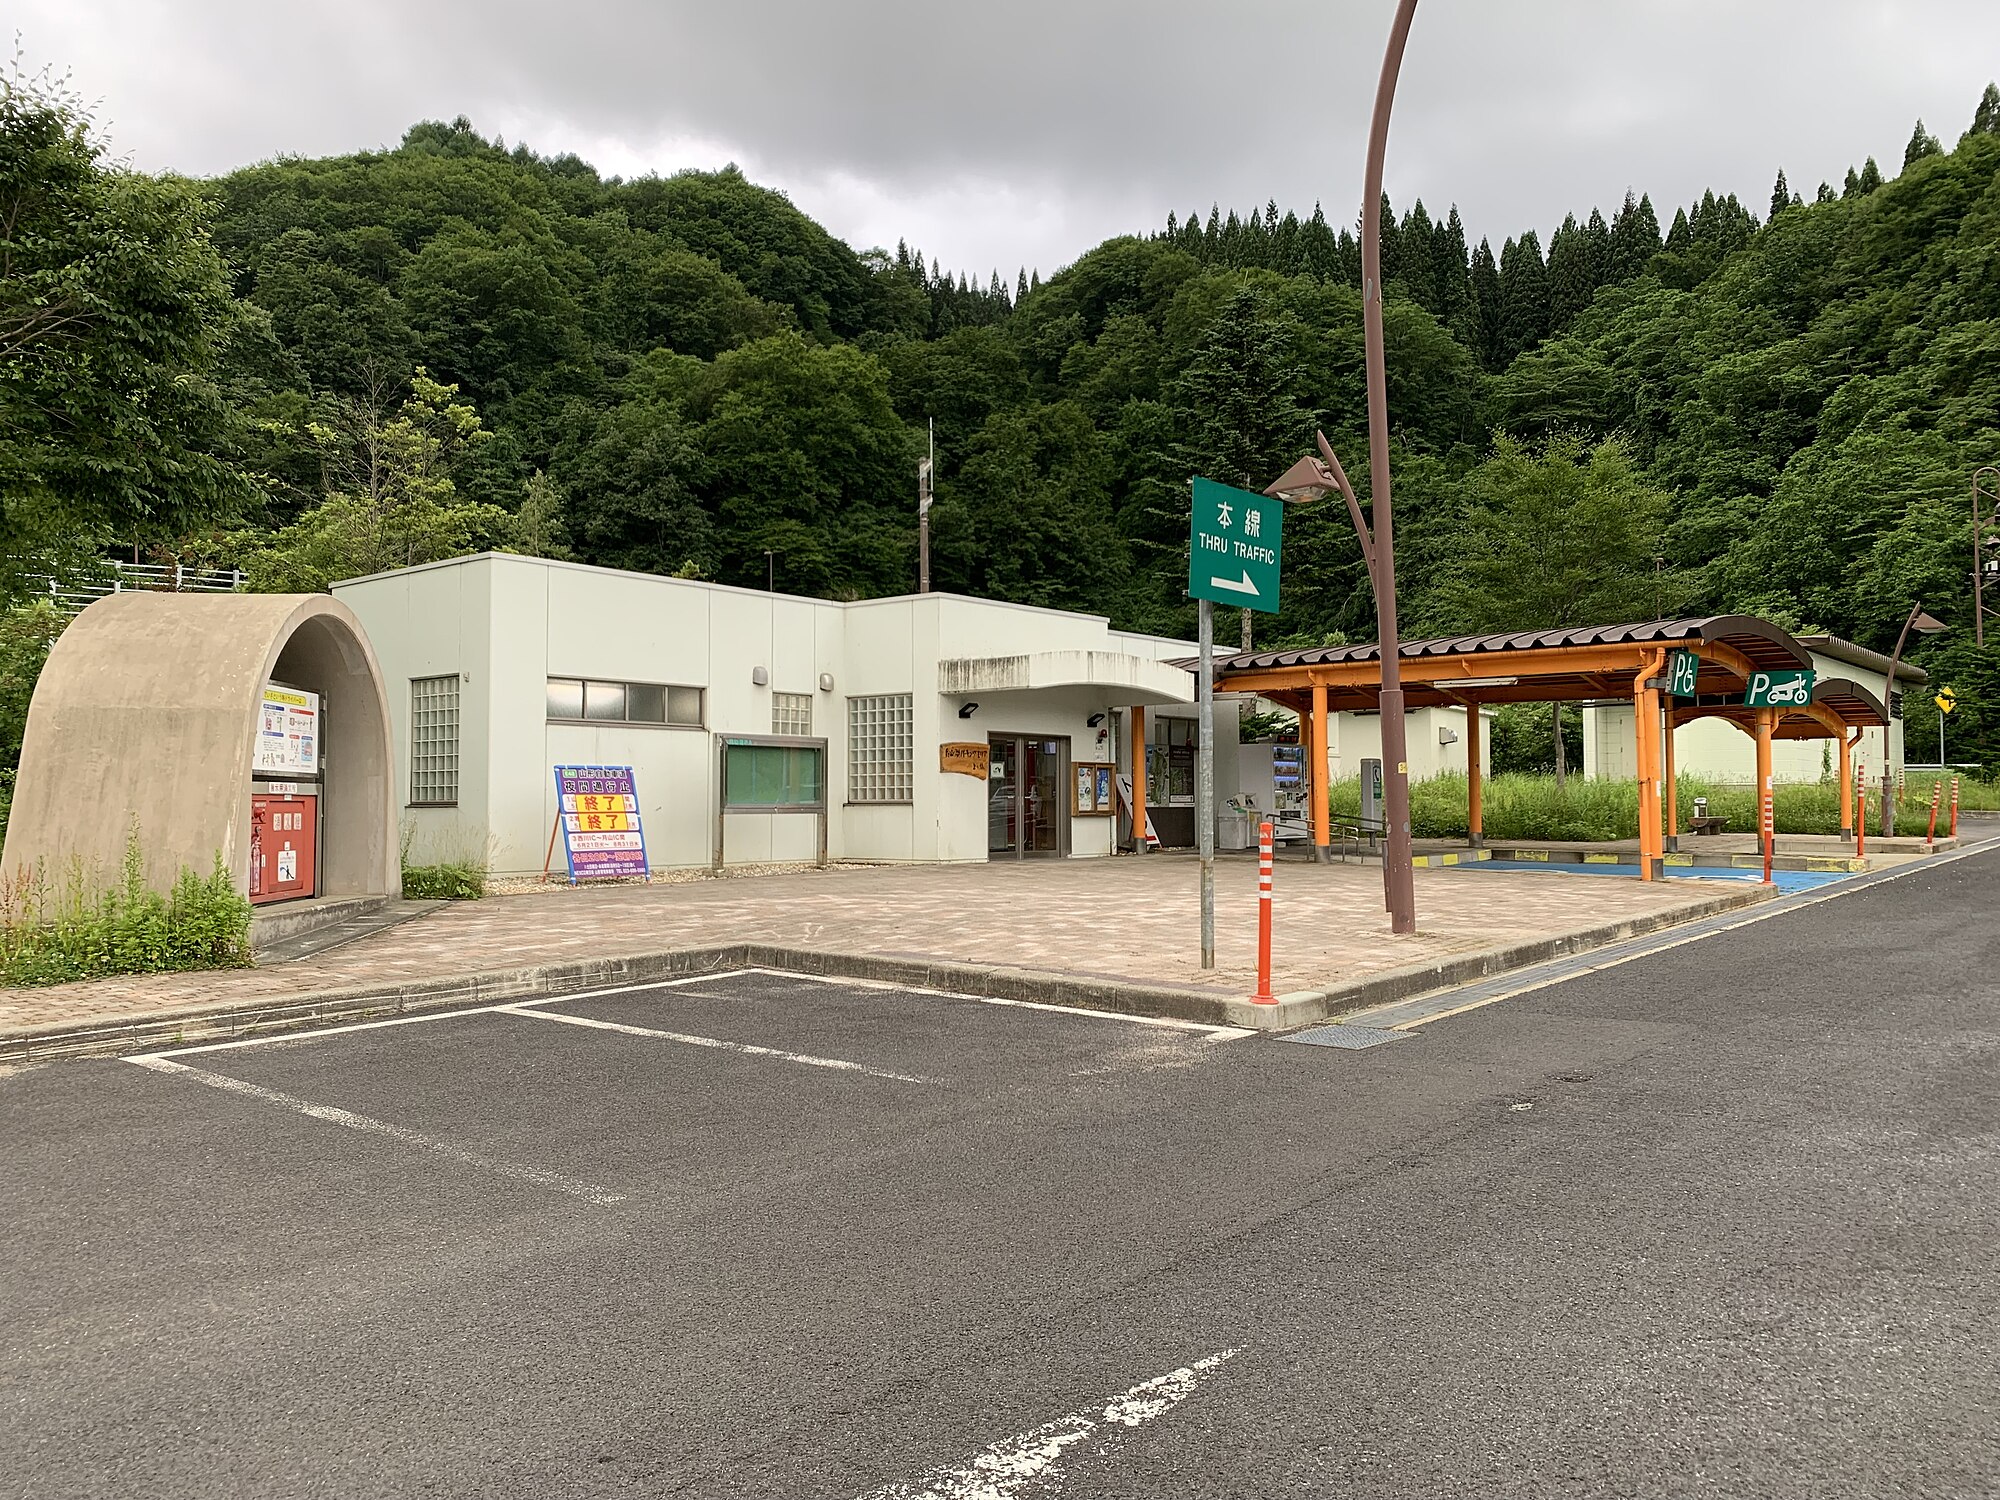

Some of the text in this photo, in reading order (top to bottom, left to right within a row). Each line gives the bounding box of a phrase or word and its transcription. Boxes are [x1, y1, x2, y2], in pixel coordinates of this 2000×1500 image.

[1217, 501, 1261, 538] 本線
[1199, 532, 1275, 565] THRU TRAFFIC
[1673, 653, 1686, 692] P
[1748, 673, 1770, 705] P
[564, 780, 630, 793] 夜間通行止
[584, 796, 615, 810] 終了
[587, 814, 618, 829] 終了
